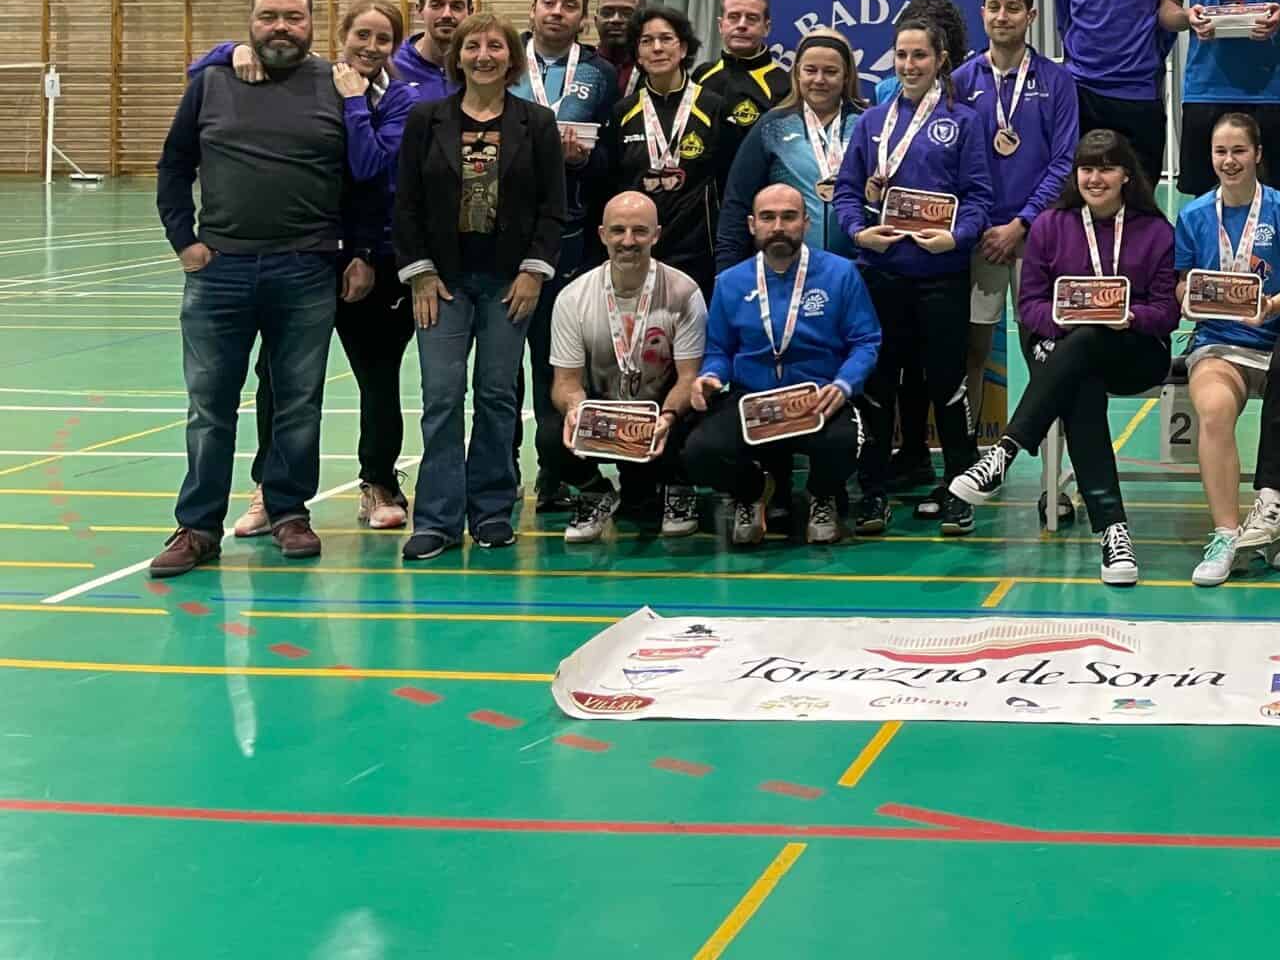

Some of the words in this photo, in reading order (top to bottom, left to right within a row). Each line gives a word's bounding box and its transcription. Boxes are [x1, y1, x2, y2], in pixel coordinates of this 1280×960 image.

[1169, 412, 1191, 445] 2
[734, 656, 987, 689] Torrezno
[996, 659, 1064, 685] de
[1067, 660, 1225, 688] Soria
[583, 696, 644, 712] VILLAR
